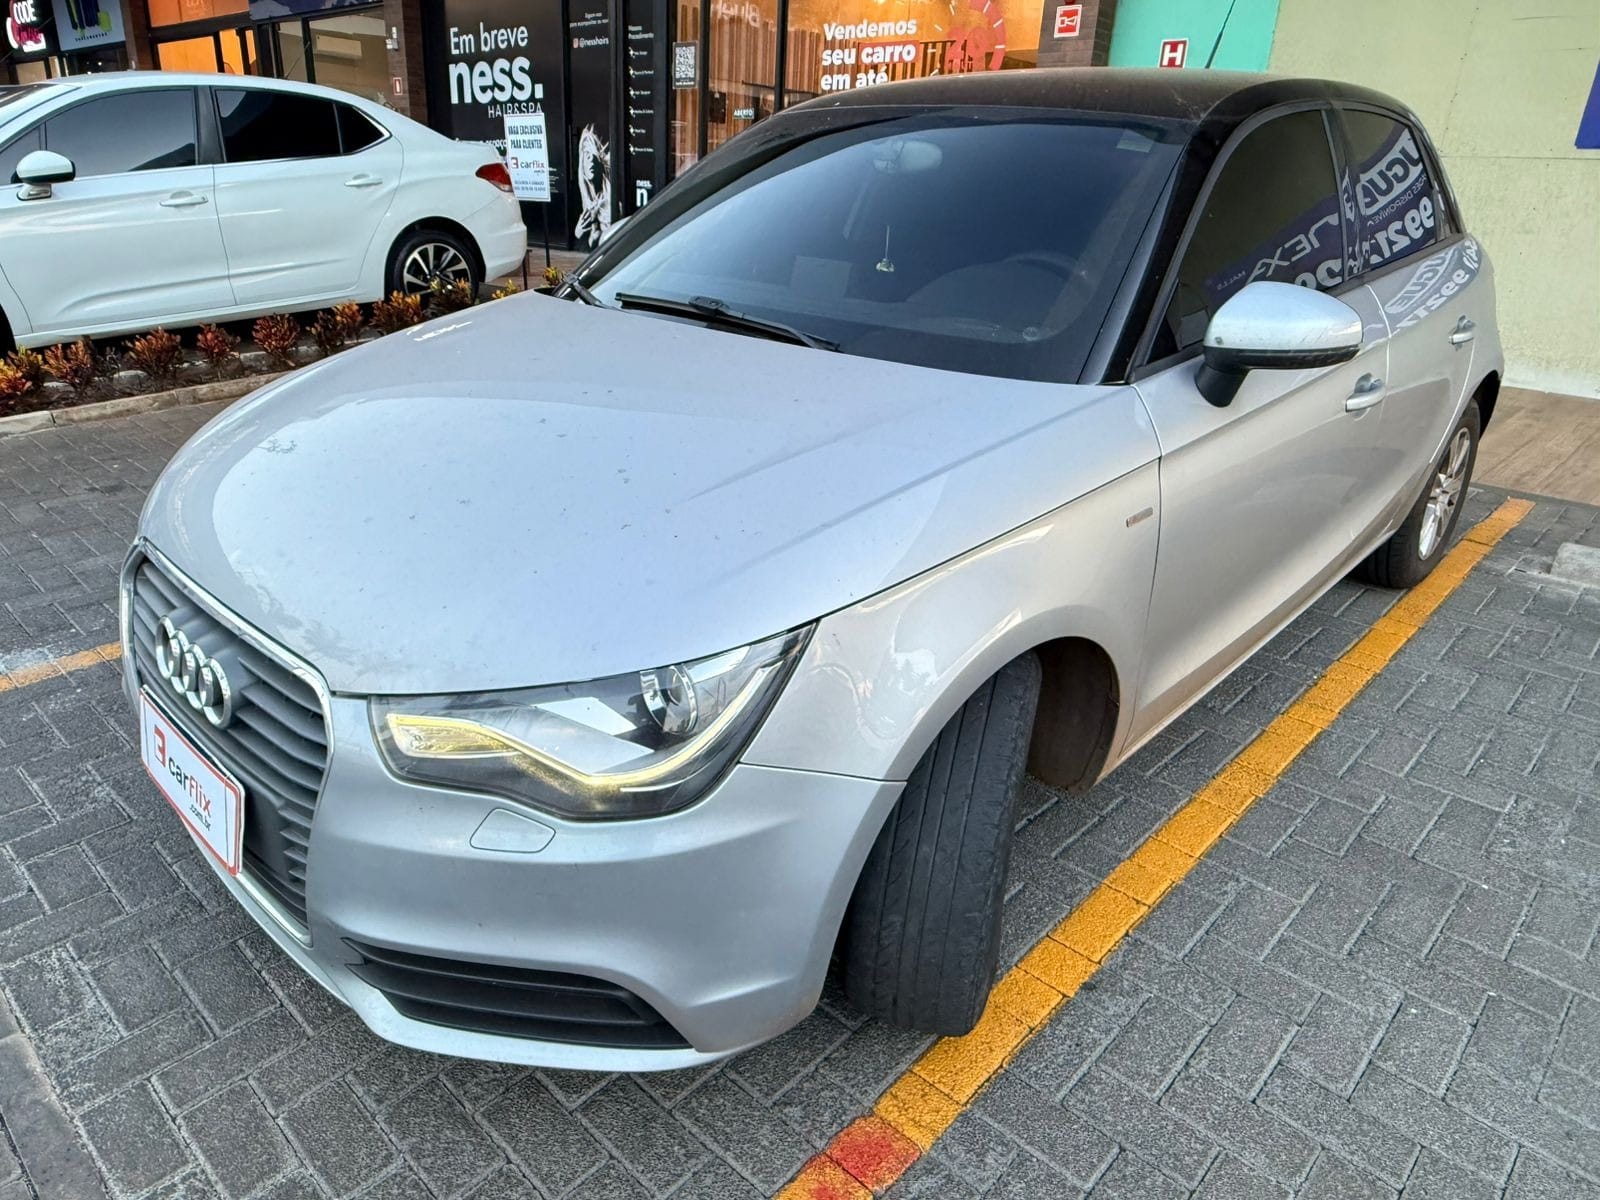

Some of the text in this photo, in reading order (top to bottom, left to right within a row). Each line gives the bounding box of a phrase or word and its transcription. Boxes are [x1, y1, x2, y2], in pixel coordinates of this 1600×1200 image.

[450, 21, 529, 55] Em breve
[823, 19, 917, 41] Vendemos
[821, 44, 916, 66] seu carro
[448, 56, 544, 105] ness.
[820, 66, 889, 90] em até
[520, 160, 545, 169] carflix
[168, 757, 212, 818] carflix
